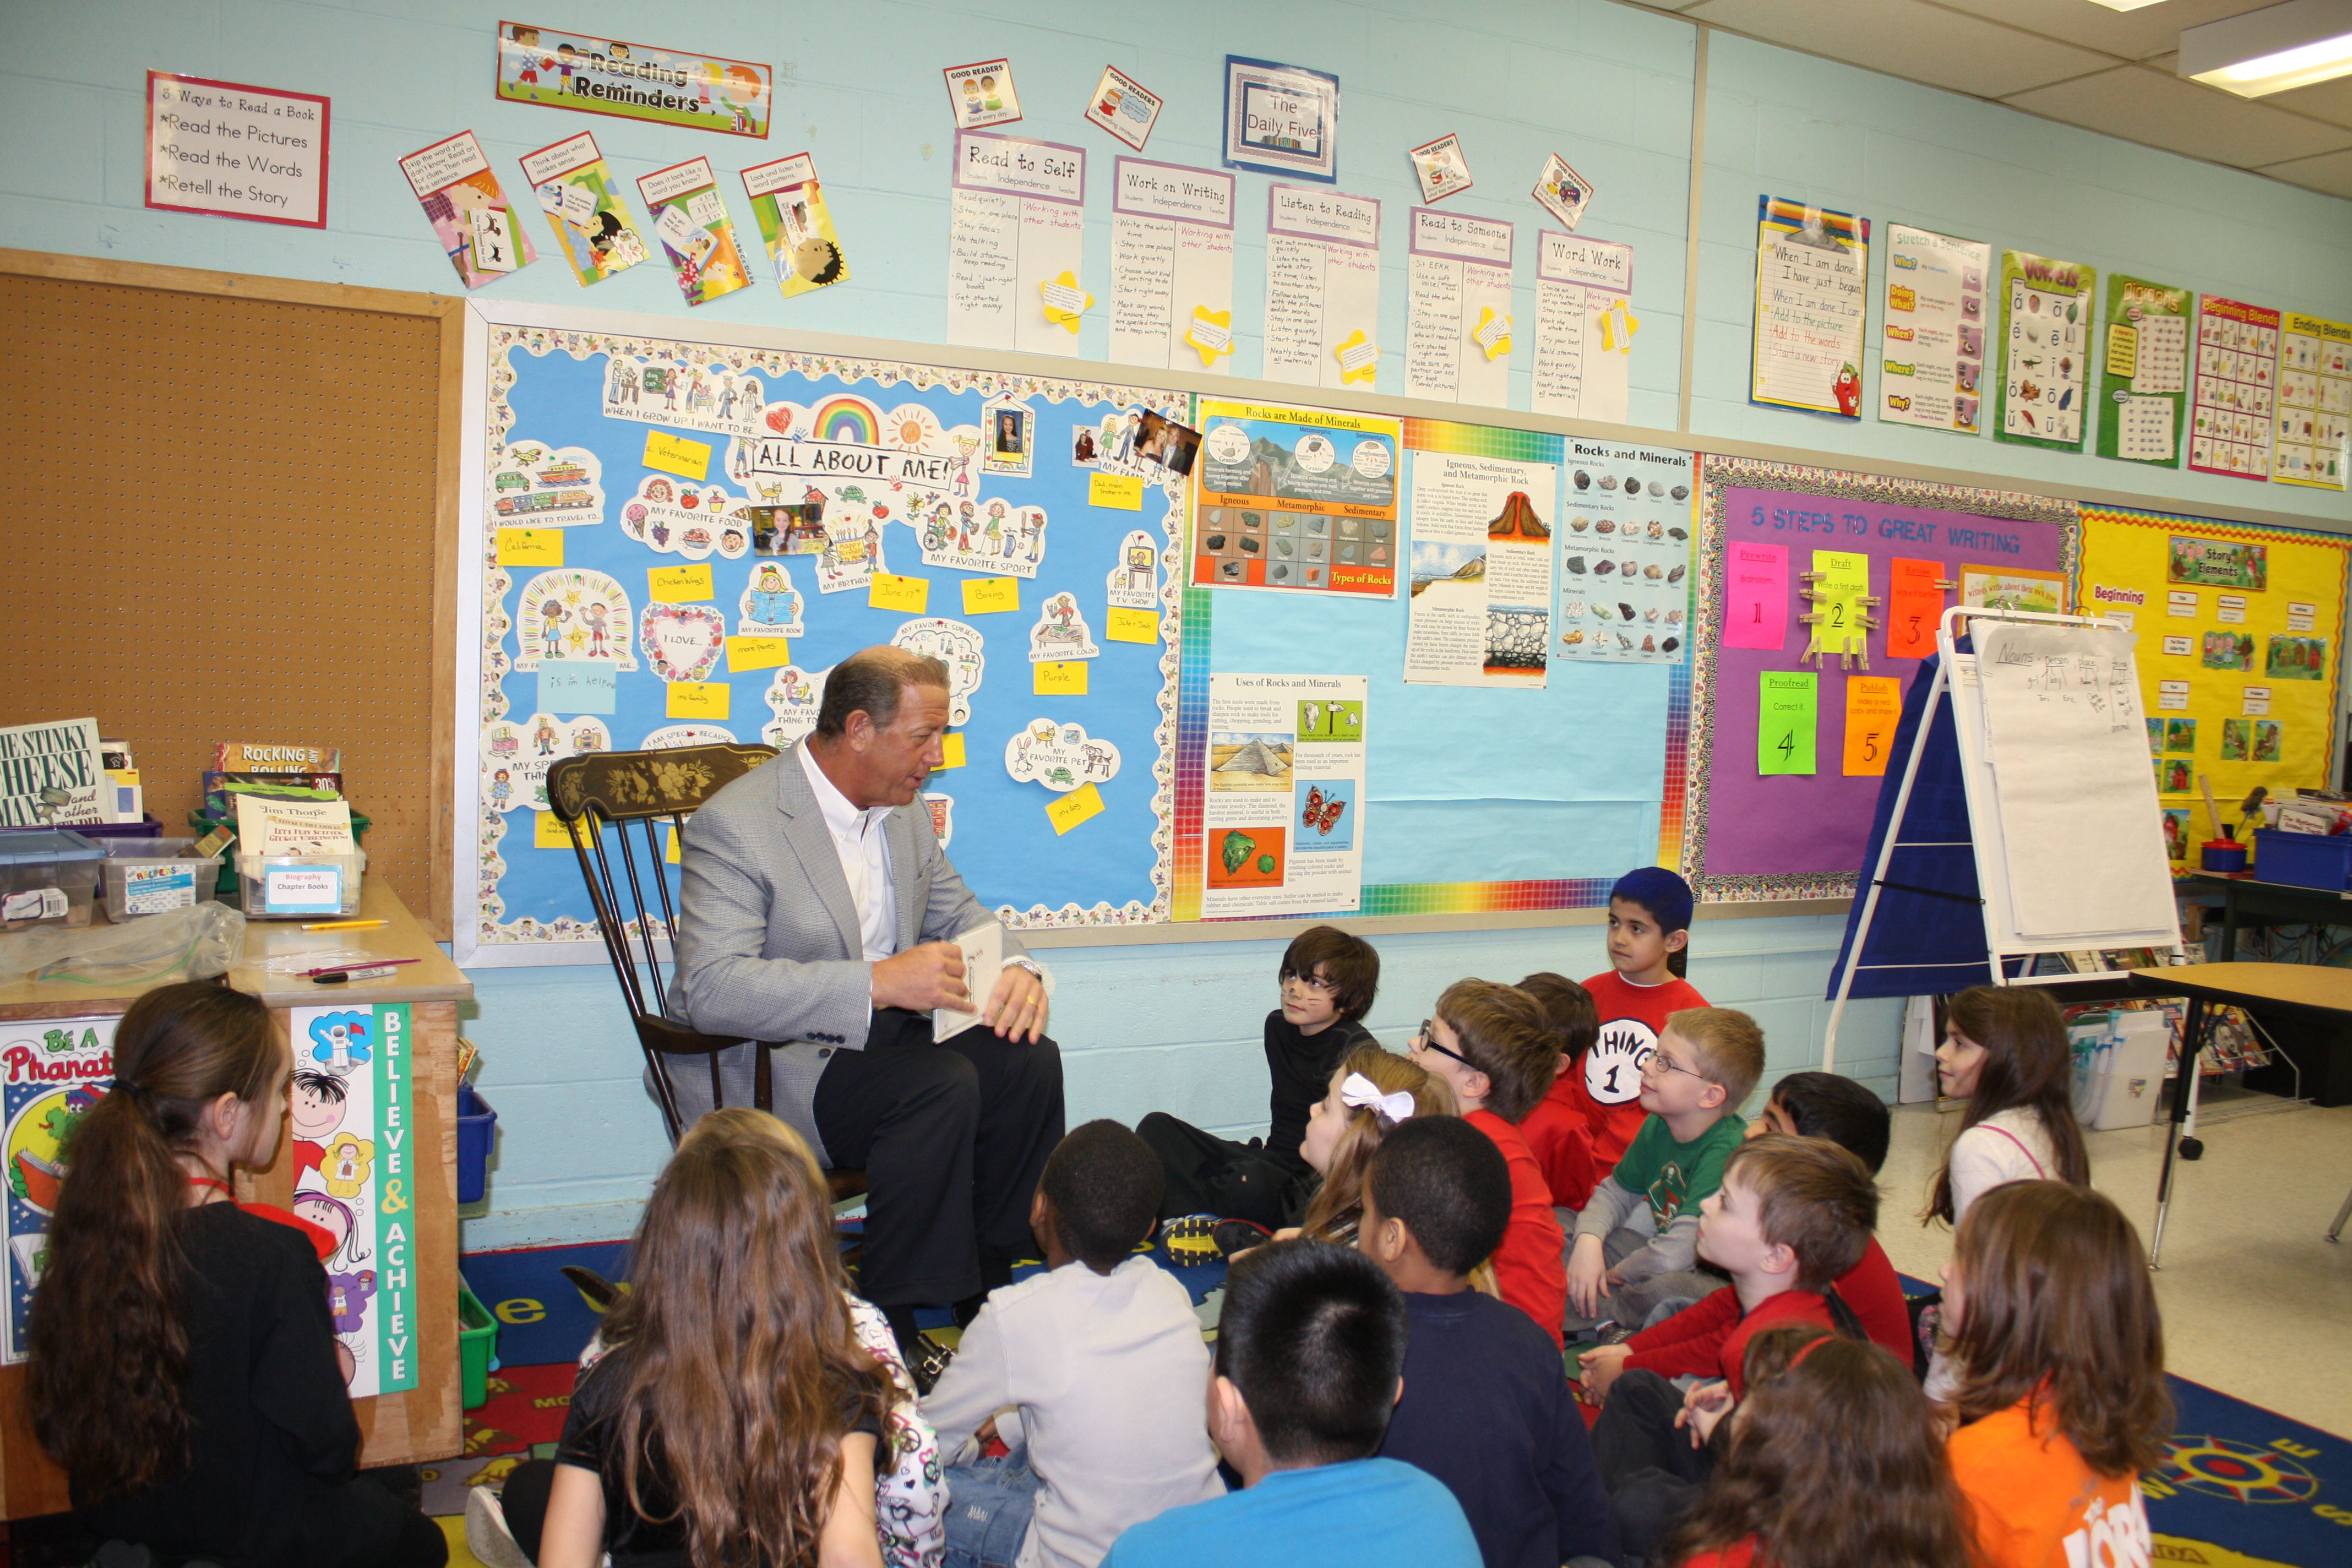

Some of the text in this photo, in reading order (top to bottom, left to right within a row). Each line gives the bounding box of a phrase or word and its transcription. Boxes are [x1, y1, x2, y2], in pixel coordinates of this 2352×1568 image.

[590, 53, 688, 88] Reading
[951, 64, 1003, 79] GOOD READERS
[574, 76, 700, 112] Reminders
[1270, 95, 1297, 113] The
[179, 90, 213, 107] Ways
[220, 96, 232, 109] to
[239, 99, 268, 114] Read
[287, 106, 314, 121] Book
[168, 114, 308, 148] Read the Pictures
[1248, 114, 1317, 139] Daily Five
[168, 144, 302, 178] Read the Words
[532, 142, 586, 168] Think about what
[970, 146, 1075, 178] Read to Self
[536, 155, 576, 176] makes sense.
[998, 173, 1050, 189] Independence
[1127, 174, 1224, 205] Work on Writing
[167, 175, 288, 208] Retell the Story
[1026, 202, 1059, 217] Working
[1281, 196, 1371, 225] Listen to Reading
[1050, 219, 1080, 229] students
[1422, 215, 1506, 239] Read to Someone
[970, 237, 998, 249] talking
[1897, 233, 1930, 247] Stretch
[1940, 241, 1981, 260] Sentence
[1553, 243, 1621, 269] Word Work
[1803, 252, 1811, 266] I
[1816, 259, 1829, 269] am
[1894, 256, 1917, 269] Who?
[1783, 265, 1790, 279] I
[1794, 268, 1809, 284] have
[1814, 272, 1832, 290] just
[2021, 258, 2079, 288] Vowels
[1890, 286, 1914, 300] Doing
[2124, 282, 2179, 312] Digraphs
[1890, 297, 1915, 311] What?
[2203, 299, 2278, 326] Beginning Blends
[1887, 325, 1913, 340] When?
[2294, 318, 2350, 339] Ending Blends
[1885, 362, 1914, 375] Where?
[1889, 396, 1910, 410] Why?
[605, 406, 633, 418] WHEN
[643, 412, 671, 423] GROW
[673, 416, 687, 425] UP
[697, 420, 725, 431] WANT
[727, 423, 739, 432] TO
[1245, 407, 1361, 428] Rocks are Made of Minerals
[658, 446, 703, 466] Veterinarian
[760, 445, 949, 480] ALL ABOUT ME!
[1575, 444, 1686, 467] Rocks and Minerals
[1446, 459, 1527, 476] Igneous, Sedimentary,
[1460, 471, 1509, 484] Metamorphic
[1511, 476, 1529, 485] Rock
[1221, 495, 1249, 507] Igneous
[1277, 500, 1325, 511] Metamorphic
[651, 506, 743, 527] MY FAVORITE FOOD
[1344, 505, 1386, 519] Sedimentary
[1752, 507, 2021, 554] 5 STEPS TO GREAT WRITING
[505, 538, 547, 551] California
[931, 554, 1032, 574] MY FAVORITE SPORT
[1740, 549, 1777, 562] Prewrite
[1831, 558, 1852, 568] Draft
[2207, 548, 2231, 562] Story
[1332, 572, 1391, 585] Types of Rocks
[2198, 562, 2238, 578] Elements
[975, 589, 1005, 600] Boxing
[1989, 583, 2003, 592] write
[2004, 582, 2020, 591] about
[2021, 582, 2034, 591] their
[2095, 586, 2144, 605] Beginning
[1753, 603, 1761, 624] 1
[1831, 603, 1845, 628] 2
[1907, 616, 1920, 644] 3
[1043, 671, 1071, 683] Purple
[1236, 678, 1341, 688] Uses of Rocks and Minerals
[1769, 677, 1809, 689] Proofread
[1860, 683, 1888, 693] Publish
[23, 725, 88, 756] STINKY
[1777, 729, 1795, 761] 4
[1863, 733, 1880, 761] 5
[243, 745, 318, 763] ROCKING AND
[0, 749, 96, 796] HEESE
[71, 790, 96, 803] and
[64, 805, 99, 816] other
[259, 805, 326, 818] Jim Thorpe
[277, 883, 307, 892] Chapter
[285, 873, 322, 883] Biography
[44, 1028, 98, 1053] BE A
[3, 1046, 115, 1081] Phanat
[1603, 1065, 1620, 1093] 1
[384, 1011, 404, 1174] BELIEVE
[382, 1179, 408, 1214] &
[385, 1223, 407, 1380] ACHIEVE
